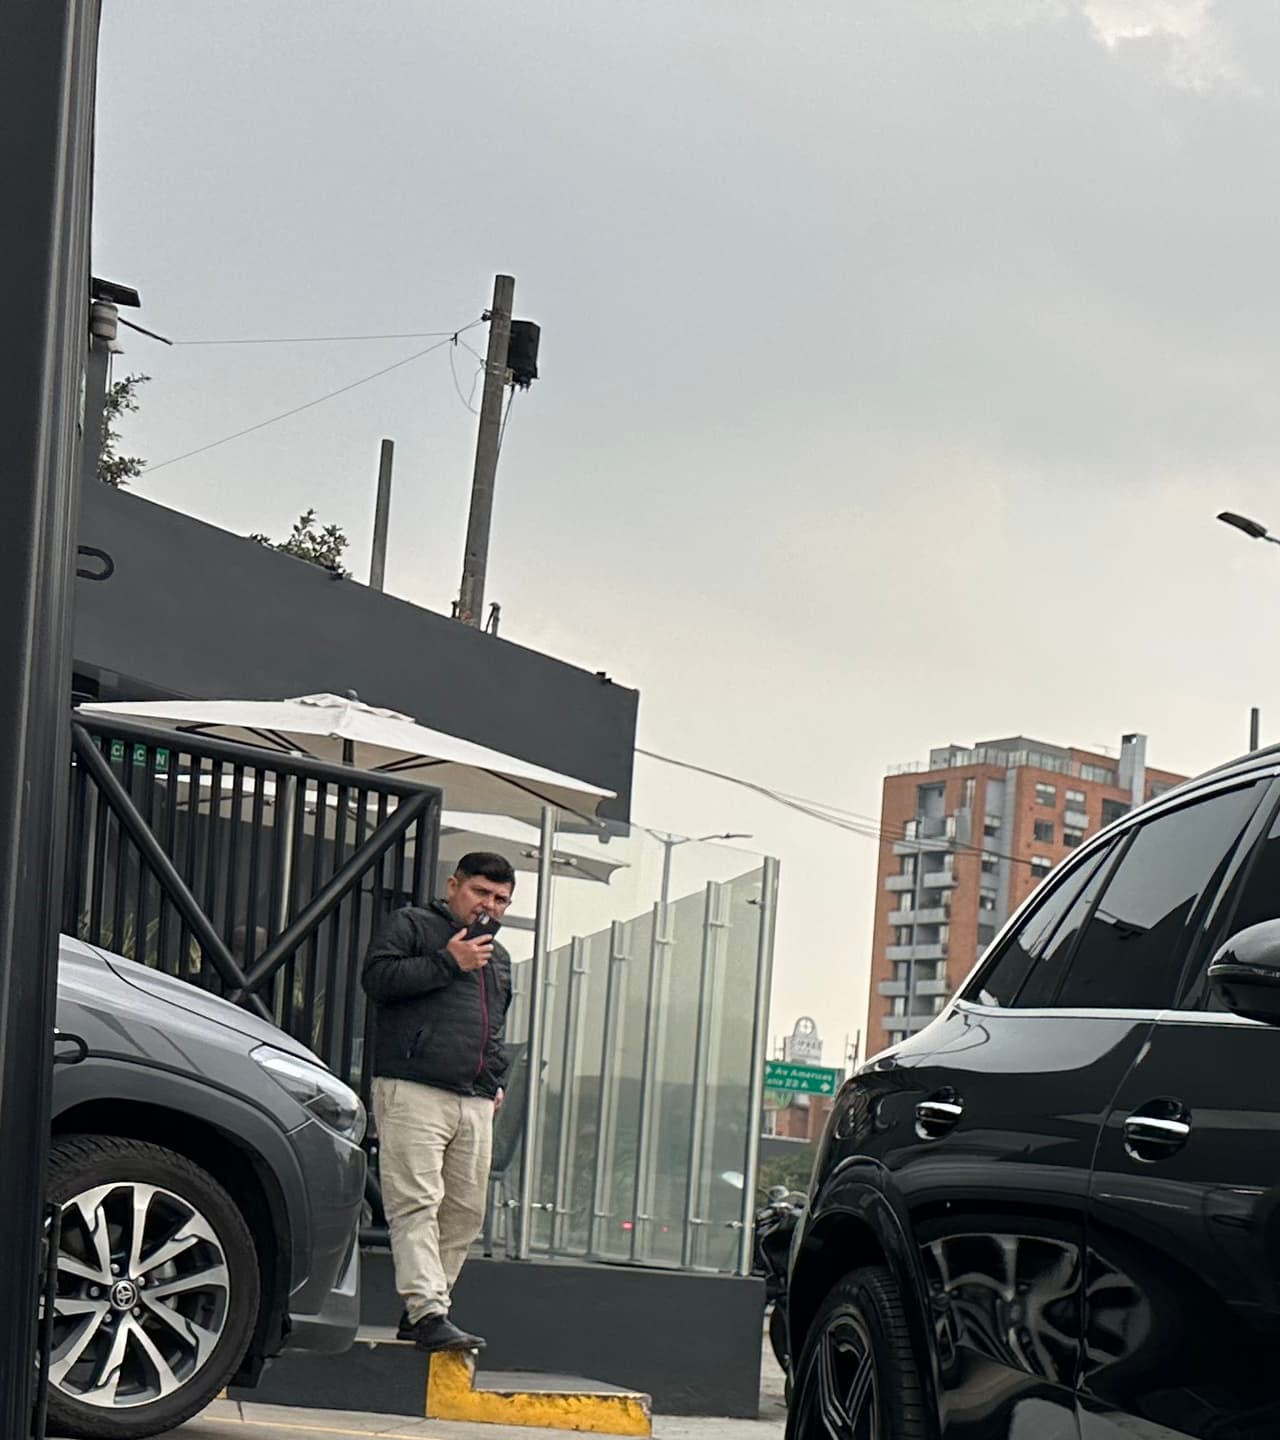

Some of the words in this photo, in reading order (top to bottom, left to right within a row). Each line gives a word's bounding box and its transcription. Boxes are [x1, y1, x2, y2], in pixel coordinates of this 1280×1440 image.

[775, 1067, 788, 1077] Av
[765, 1078, 784, 1086] alle
[801, 1080, 809, 1089] A
